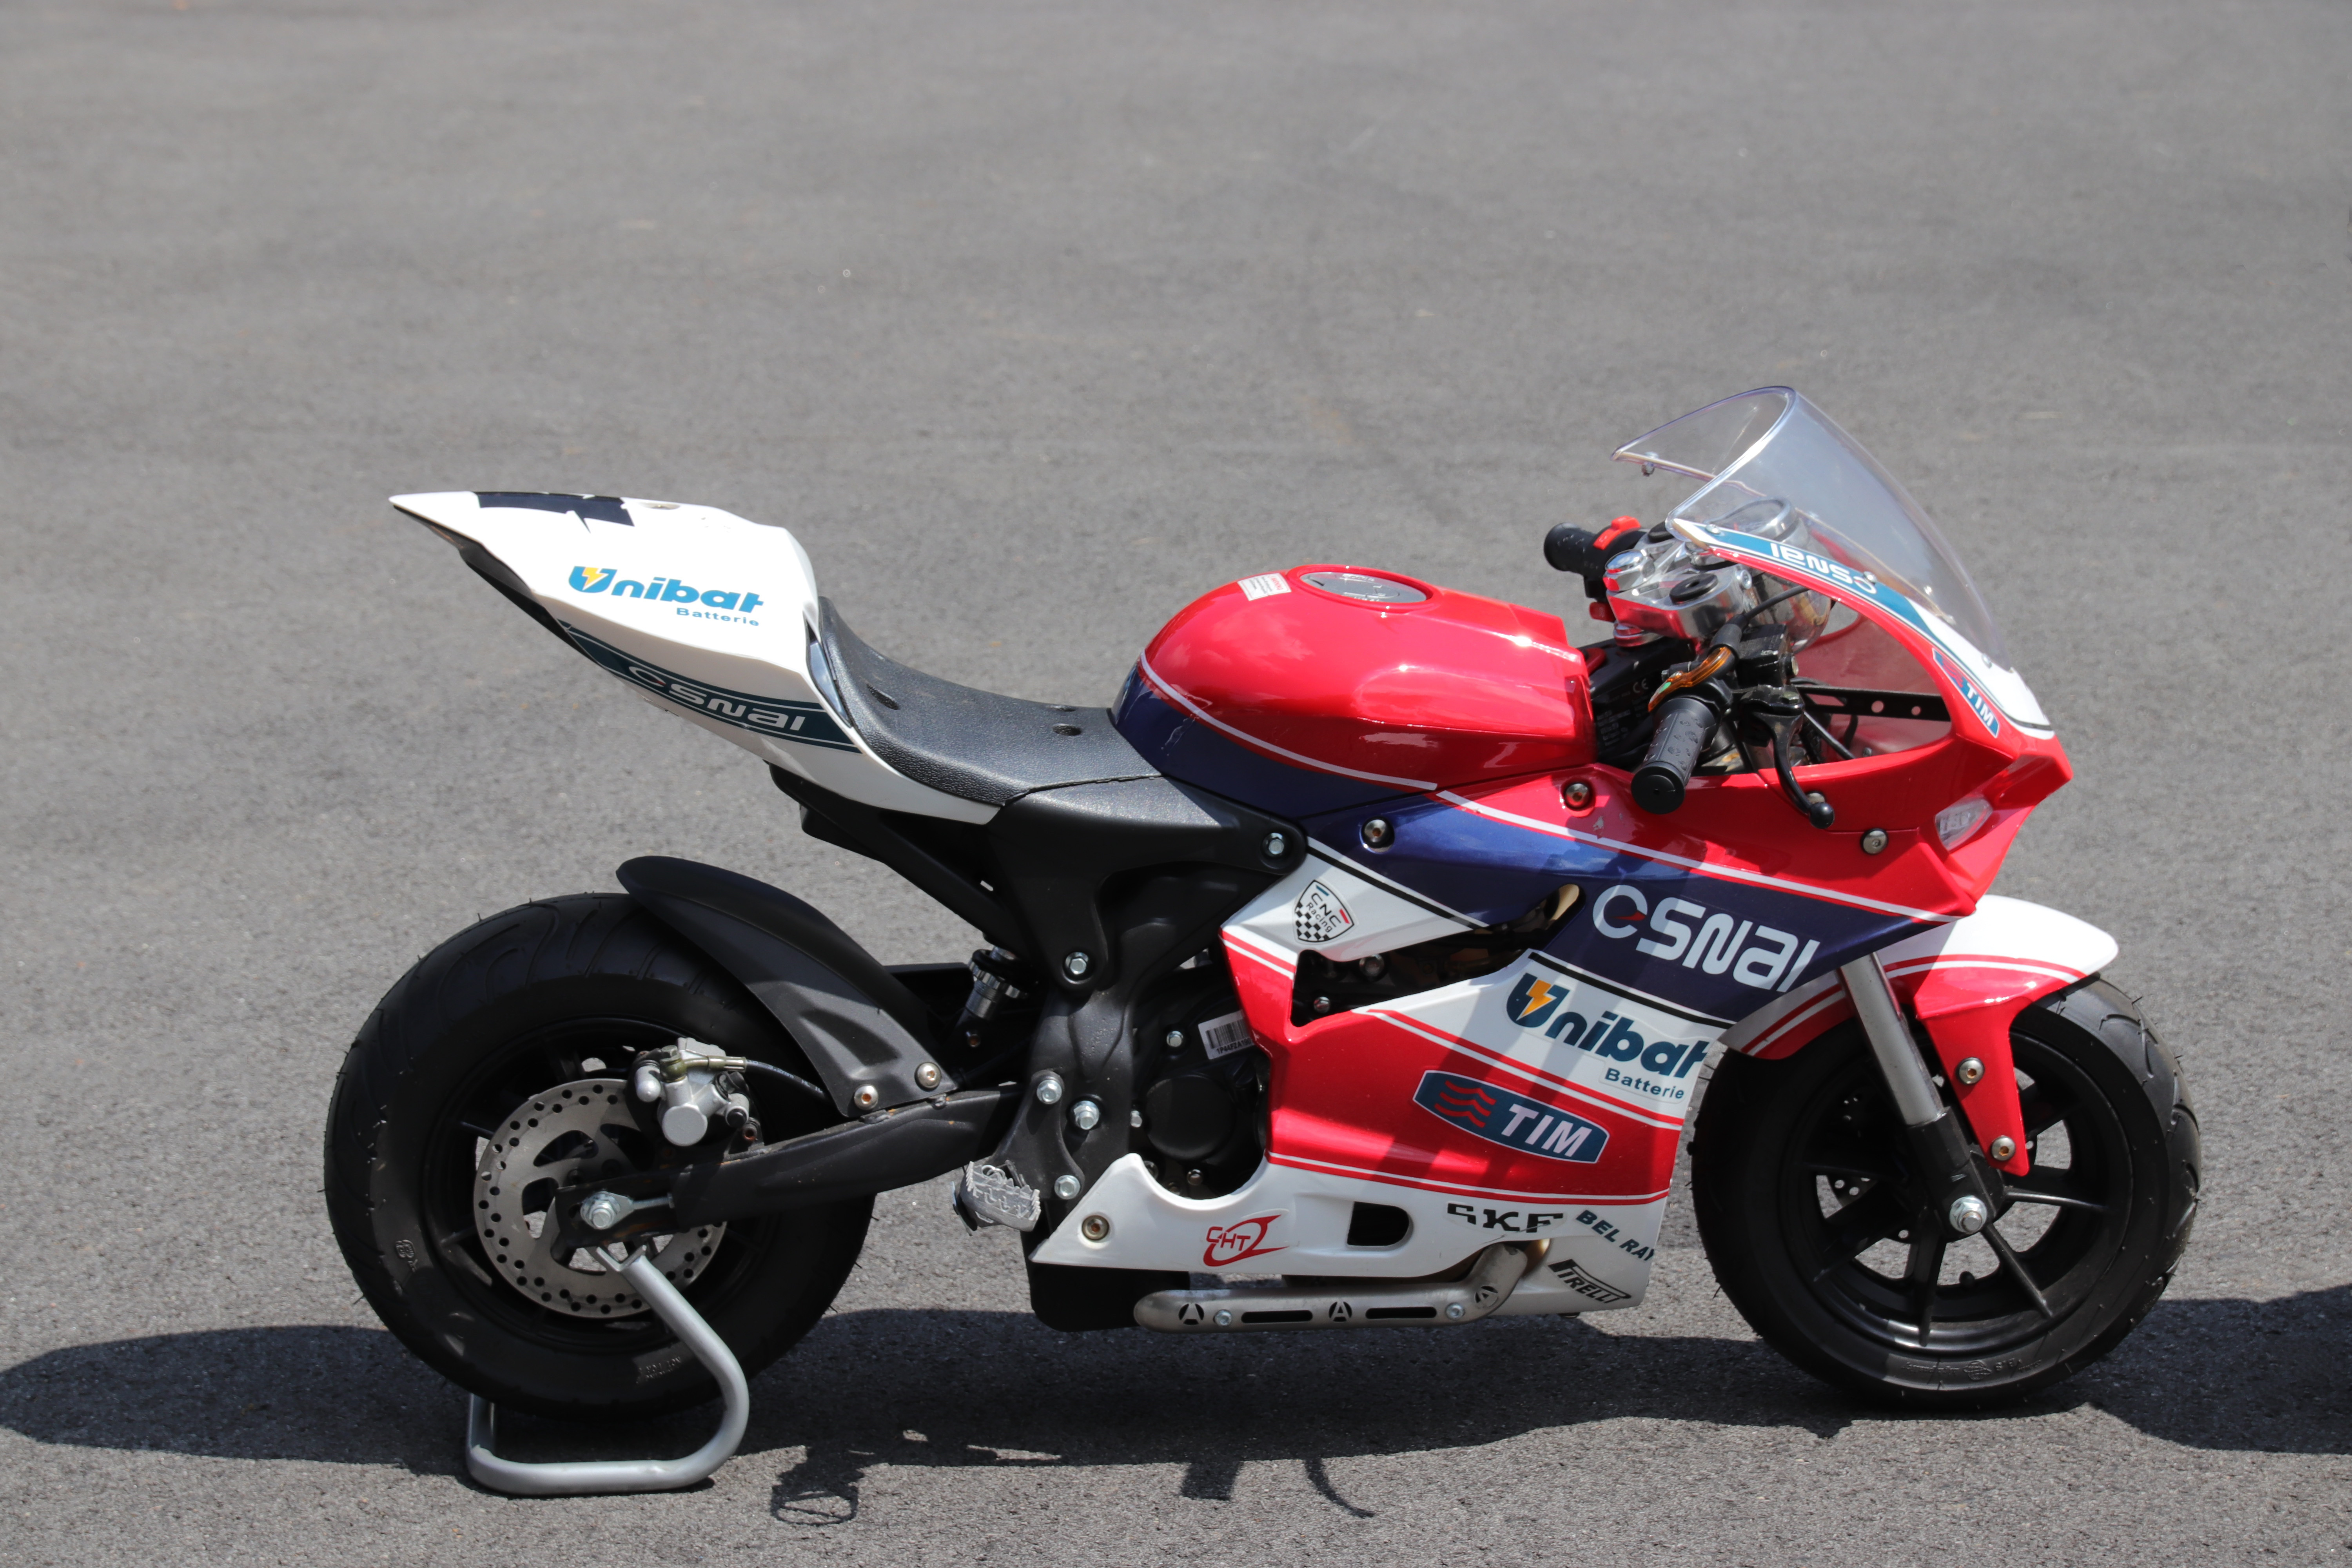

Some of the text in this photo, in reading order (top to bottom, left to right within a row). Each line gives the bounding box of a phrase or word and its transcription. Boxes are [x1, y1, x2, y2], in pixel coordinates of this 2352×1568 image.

[569, 566, 764, 613] Unibat
[676, 607, 759, 626] Batterie
[1967, 682, 1994, 727] TIM
[1306, 902, 1332, 933] Racing
[1311, 892, 1341, 927] CNC
[1506, 972, 1710, 1079] Unibat
[1604, 1067, 1684, 1099] Batterie
[1501, 1103, 1593, 1158] TIM
[1575, 1210, 1620, 1242] BEL
[1548, 1259, 1632, 1304] PIRELLI
